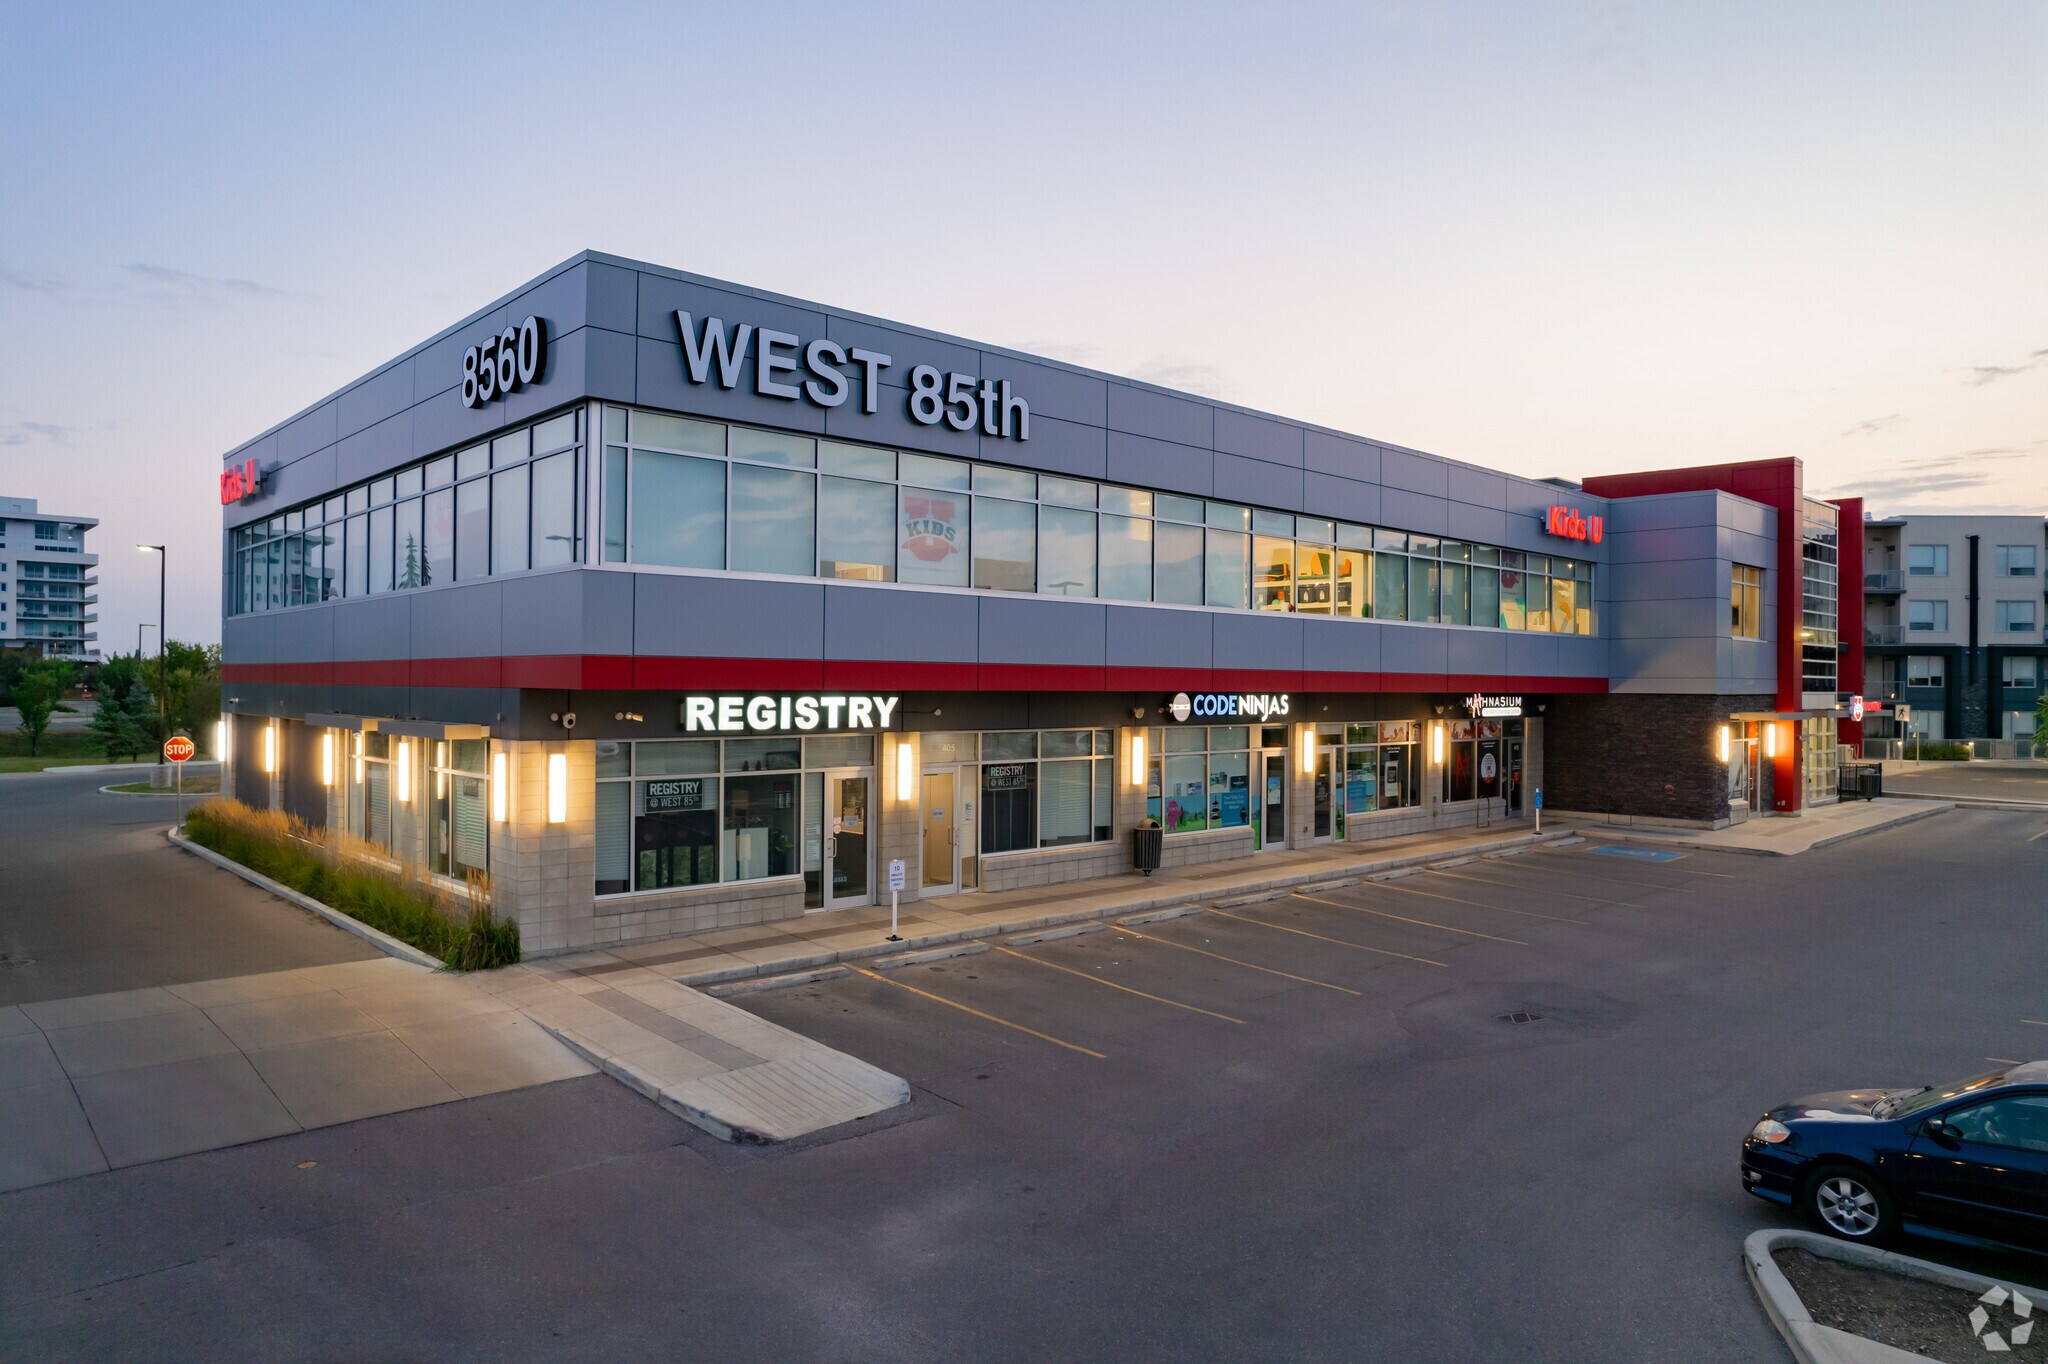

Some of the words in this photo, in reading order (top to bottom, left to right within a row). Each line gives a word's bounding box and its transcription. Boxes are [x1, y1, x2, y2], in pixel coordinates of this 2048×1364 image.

[461, 315, 545, 409] 8560
[673, 309, 892, 414] WEST
[907, 364, 1030, 441] 85th
[220, 464, 243, 505] Kids
[245, 457, 255, 495] U
[906, 519, 957, 542] KIDS
[1549, 505, 1587, 541] Kids
[1591, 515, 1603, 545] U
[686, 696, 899, 731] REGISTRY
[166, 744, 192, 755] STOP
[942, 744, 956, 752] 405
[990, 765, 1024, 777] REGISTRY
[650, 781, 700, 796] REGISTRY
[998, 777, 1011, 787] WEST
[650, 798, 659, 808] @
[661, 796, 682, 807] WEST
